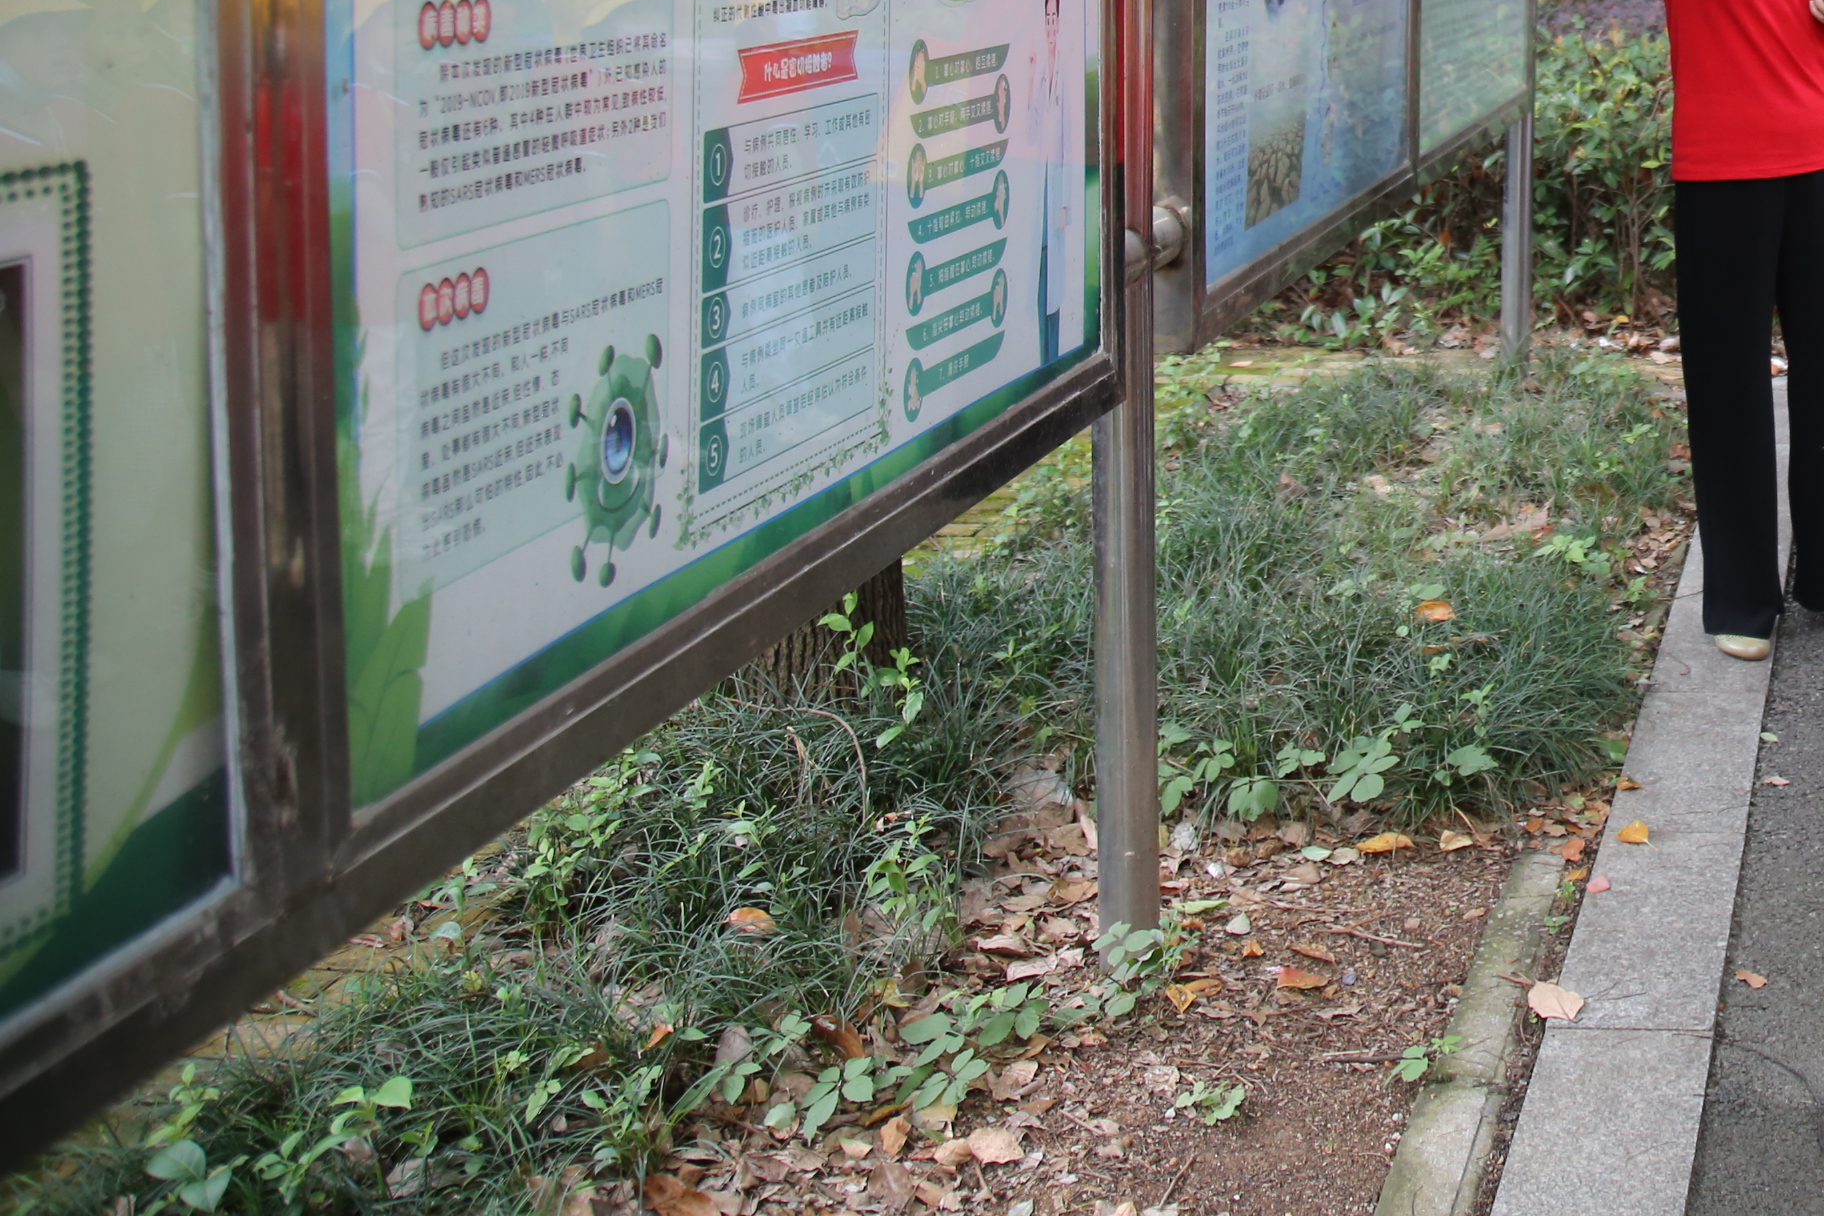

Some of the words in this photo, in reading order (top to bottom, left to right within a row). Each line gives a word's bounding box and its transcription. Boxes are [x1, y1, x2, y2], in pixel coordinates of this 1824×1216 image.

[763, 51, 833, 83] 什么是密切接触者？
[715, 152, 722, 177] 1
[713, 235, 722, 260] 2
[712, 304, 721, 331] 3
[710, 369, 719, 394] 4
[709, 443, 719, 469] 5
